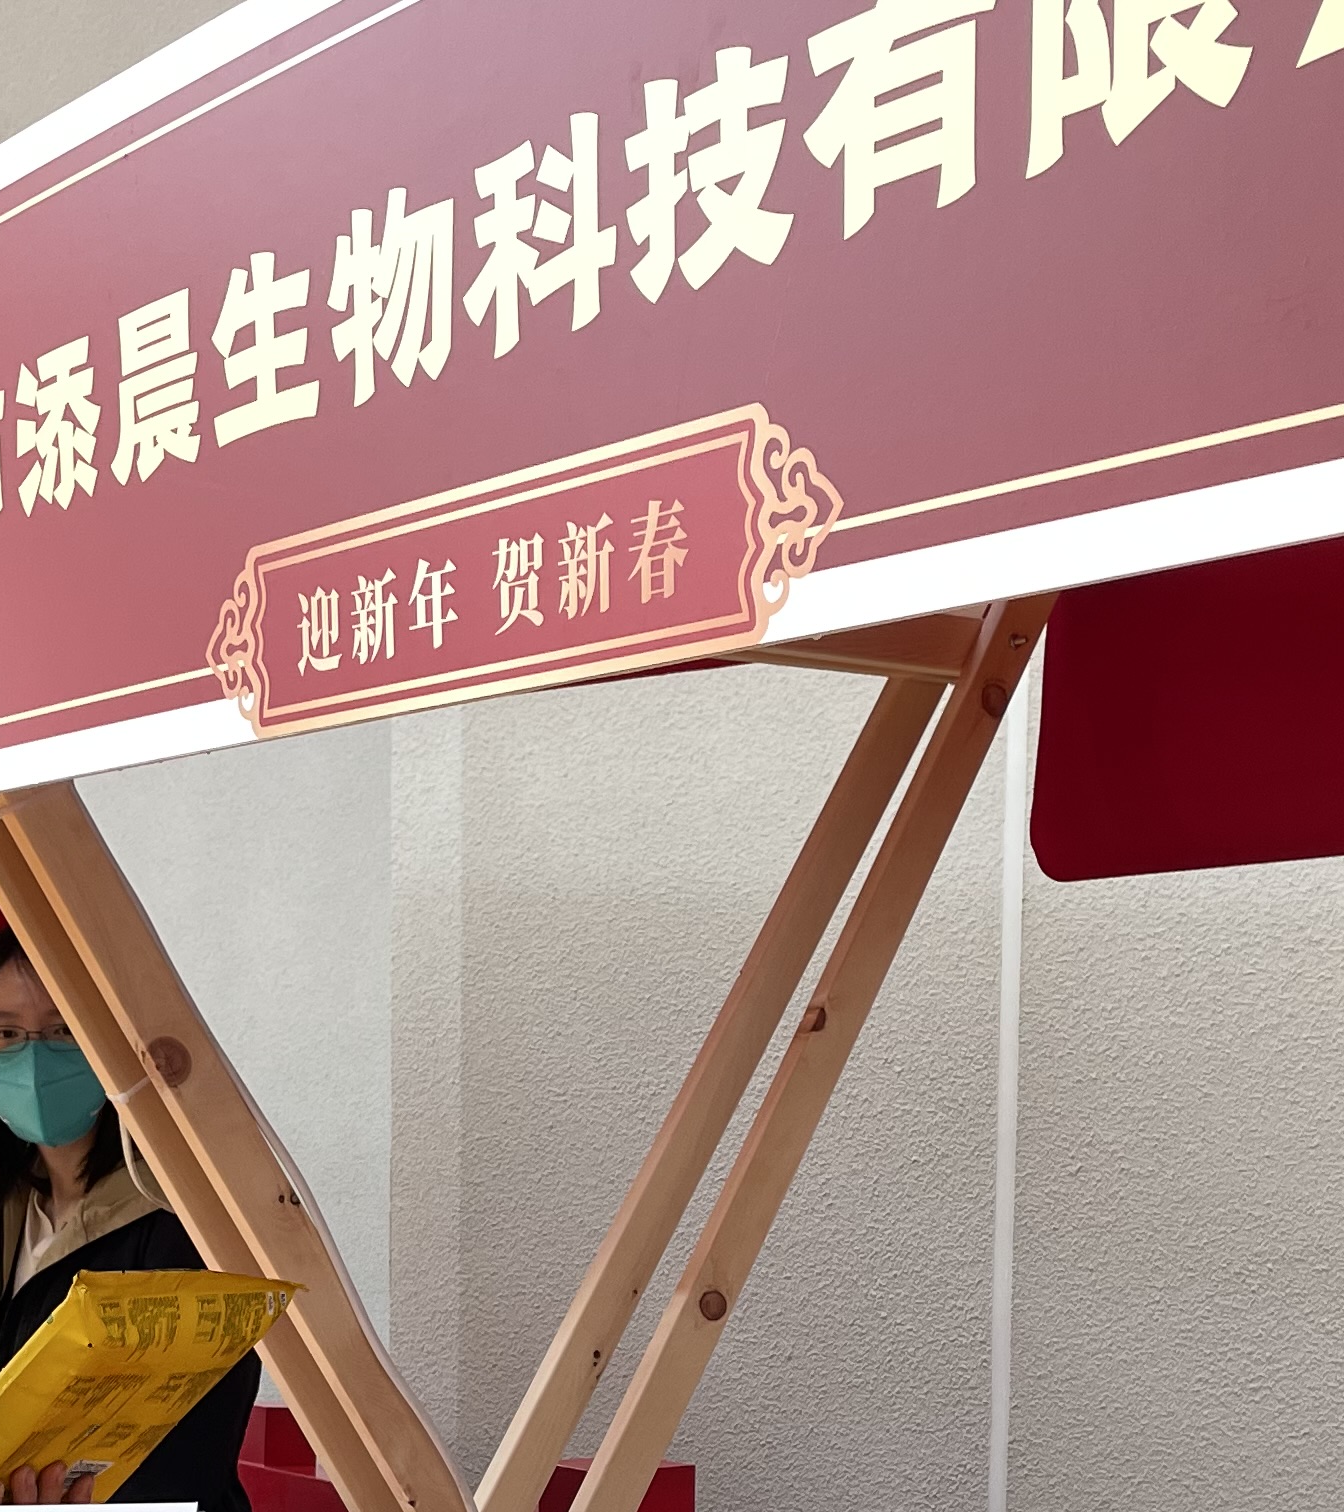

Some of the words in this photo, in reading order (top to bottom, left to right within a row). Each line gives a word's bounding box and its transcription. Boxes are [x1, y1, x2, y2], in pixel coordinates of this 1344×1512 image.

[295, 556, 458, 677] 迎新年
[491, 498, 689, 636] 贺新春
